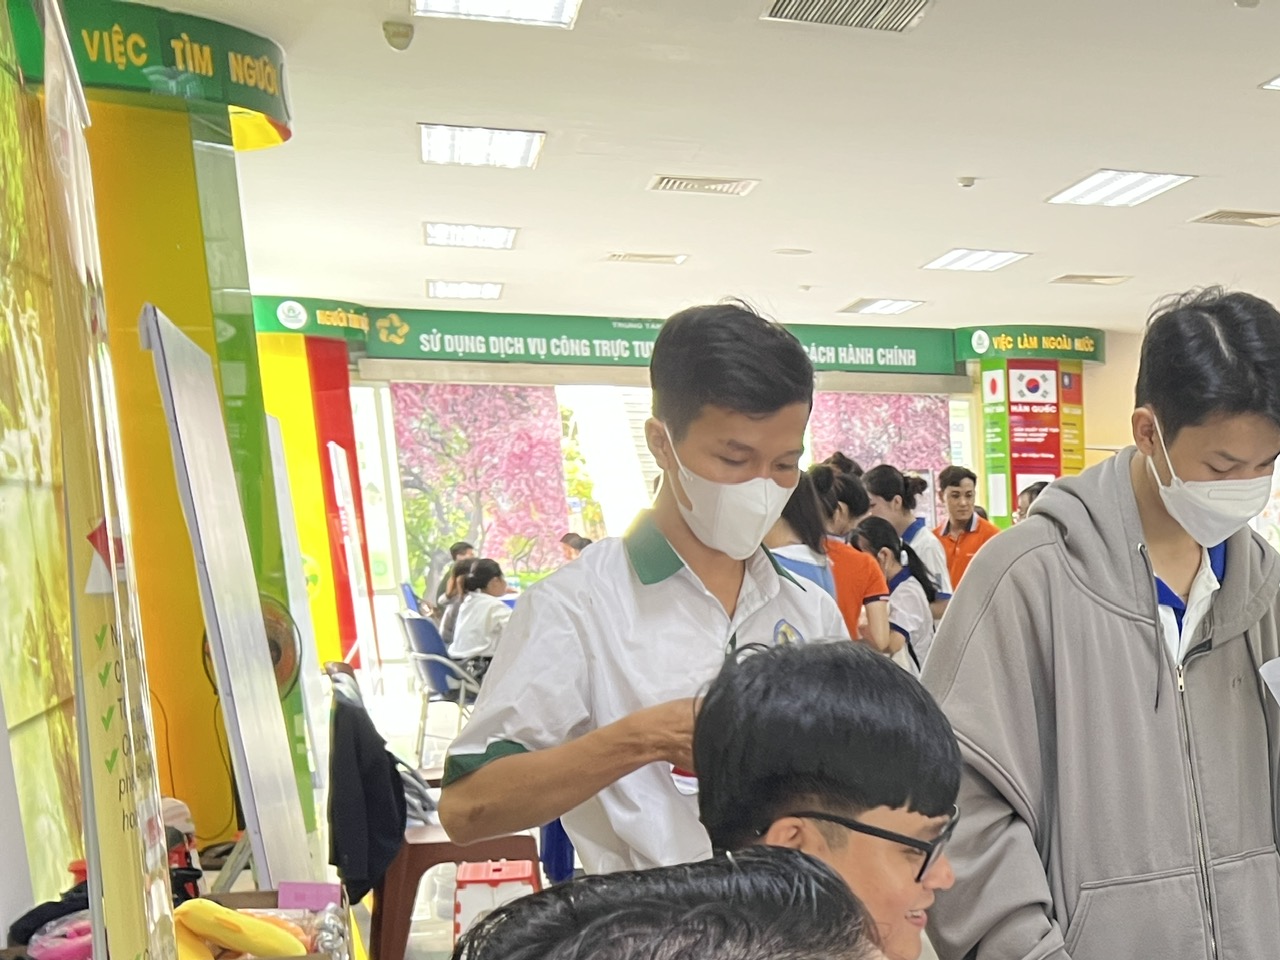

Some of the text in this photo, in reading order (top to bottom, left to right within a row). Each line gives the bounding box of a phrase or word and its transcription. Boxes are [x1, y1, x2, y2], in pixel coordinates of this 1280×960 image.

[81, 23, 148, 70] VIỆC
[170, 32, 214, 77] TÌM
[419, 328, 441, 352] SỬ
[444, 334, 486, 357] DỤNG
[489, 336, 524, 358] DỊCH
[527, 338, 546, 359] VỤ
[550, 335, 591, 357] CÔNG
[593, 338, 630, 361] TRỰC
[992, 333, 1014, 352] VIỆC
[1017, 333, 1039, 349] LÀM
[1041, 334, 1073, 350] NGOÀI
[838, 343, 875, 365] HÀNH
[876, 345, 917, 366] CHÍNH
[1010, 403, 1031, 413] HÀN
[1031, 403, 1058, 413] QUỐC
